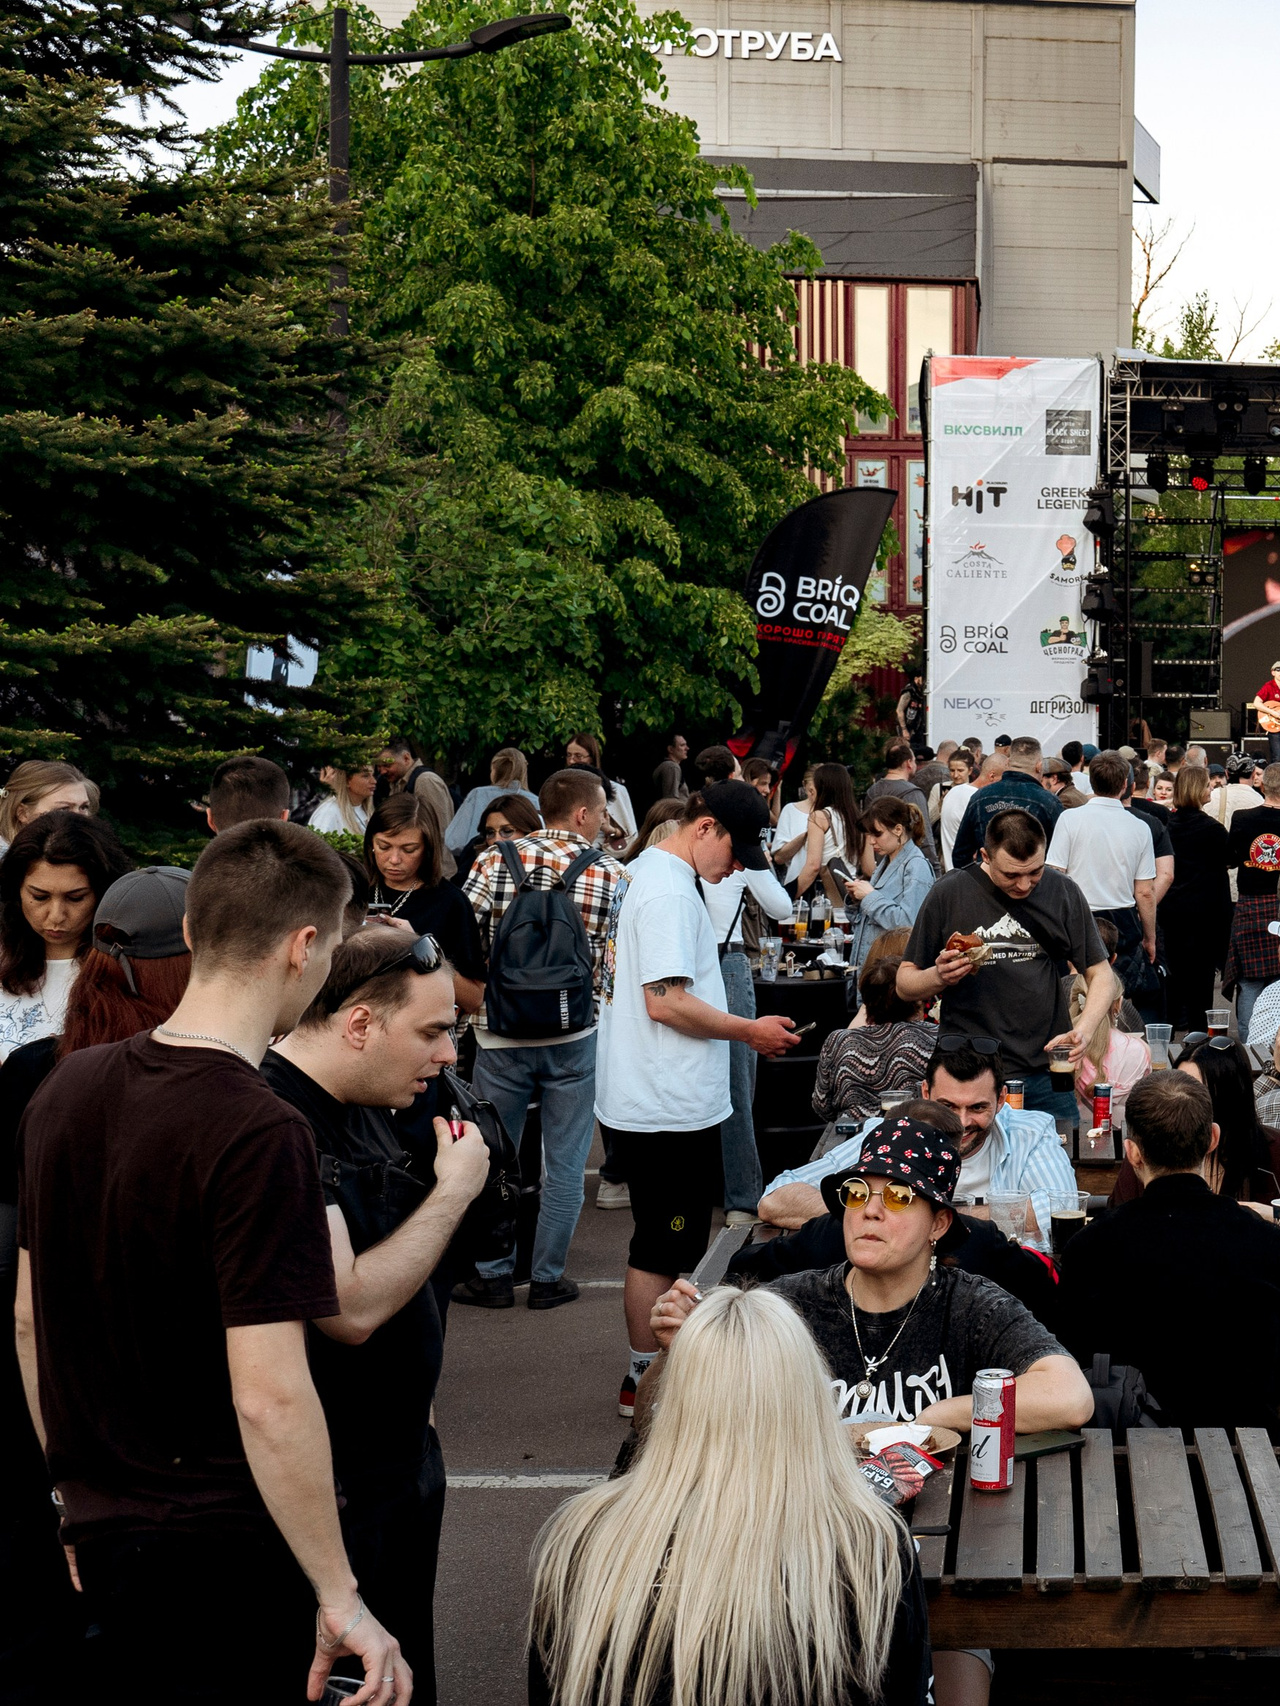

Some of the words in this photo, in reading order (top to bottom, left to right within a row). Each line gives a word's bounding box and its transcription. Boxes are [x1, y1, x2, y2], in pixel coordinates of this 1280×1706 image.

[944, 424, 1023, 437] ВКУСВИЛЛ
[963, 561, 992, 569] COSTA
[946, 569, 1008, 579] CALIENTE
[793, 601, 851, 631] COAL
[963, 641, 1009, 654] COAL
[1043, 646, 1085, 658] ЧЕСНОГРАД
[943, 698, 993, 709] NEKO
[1030, 700, 1090, 714] ДЕГРИЗОЛ
